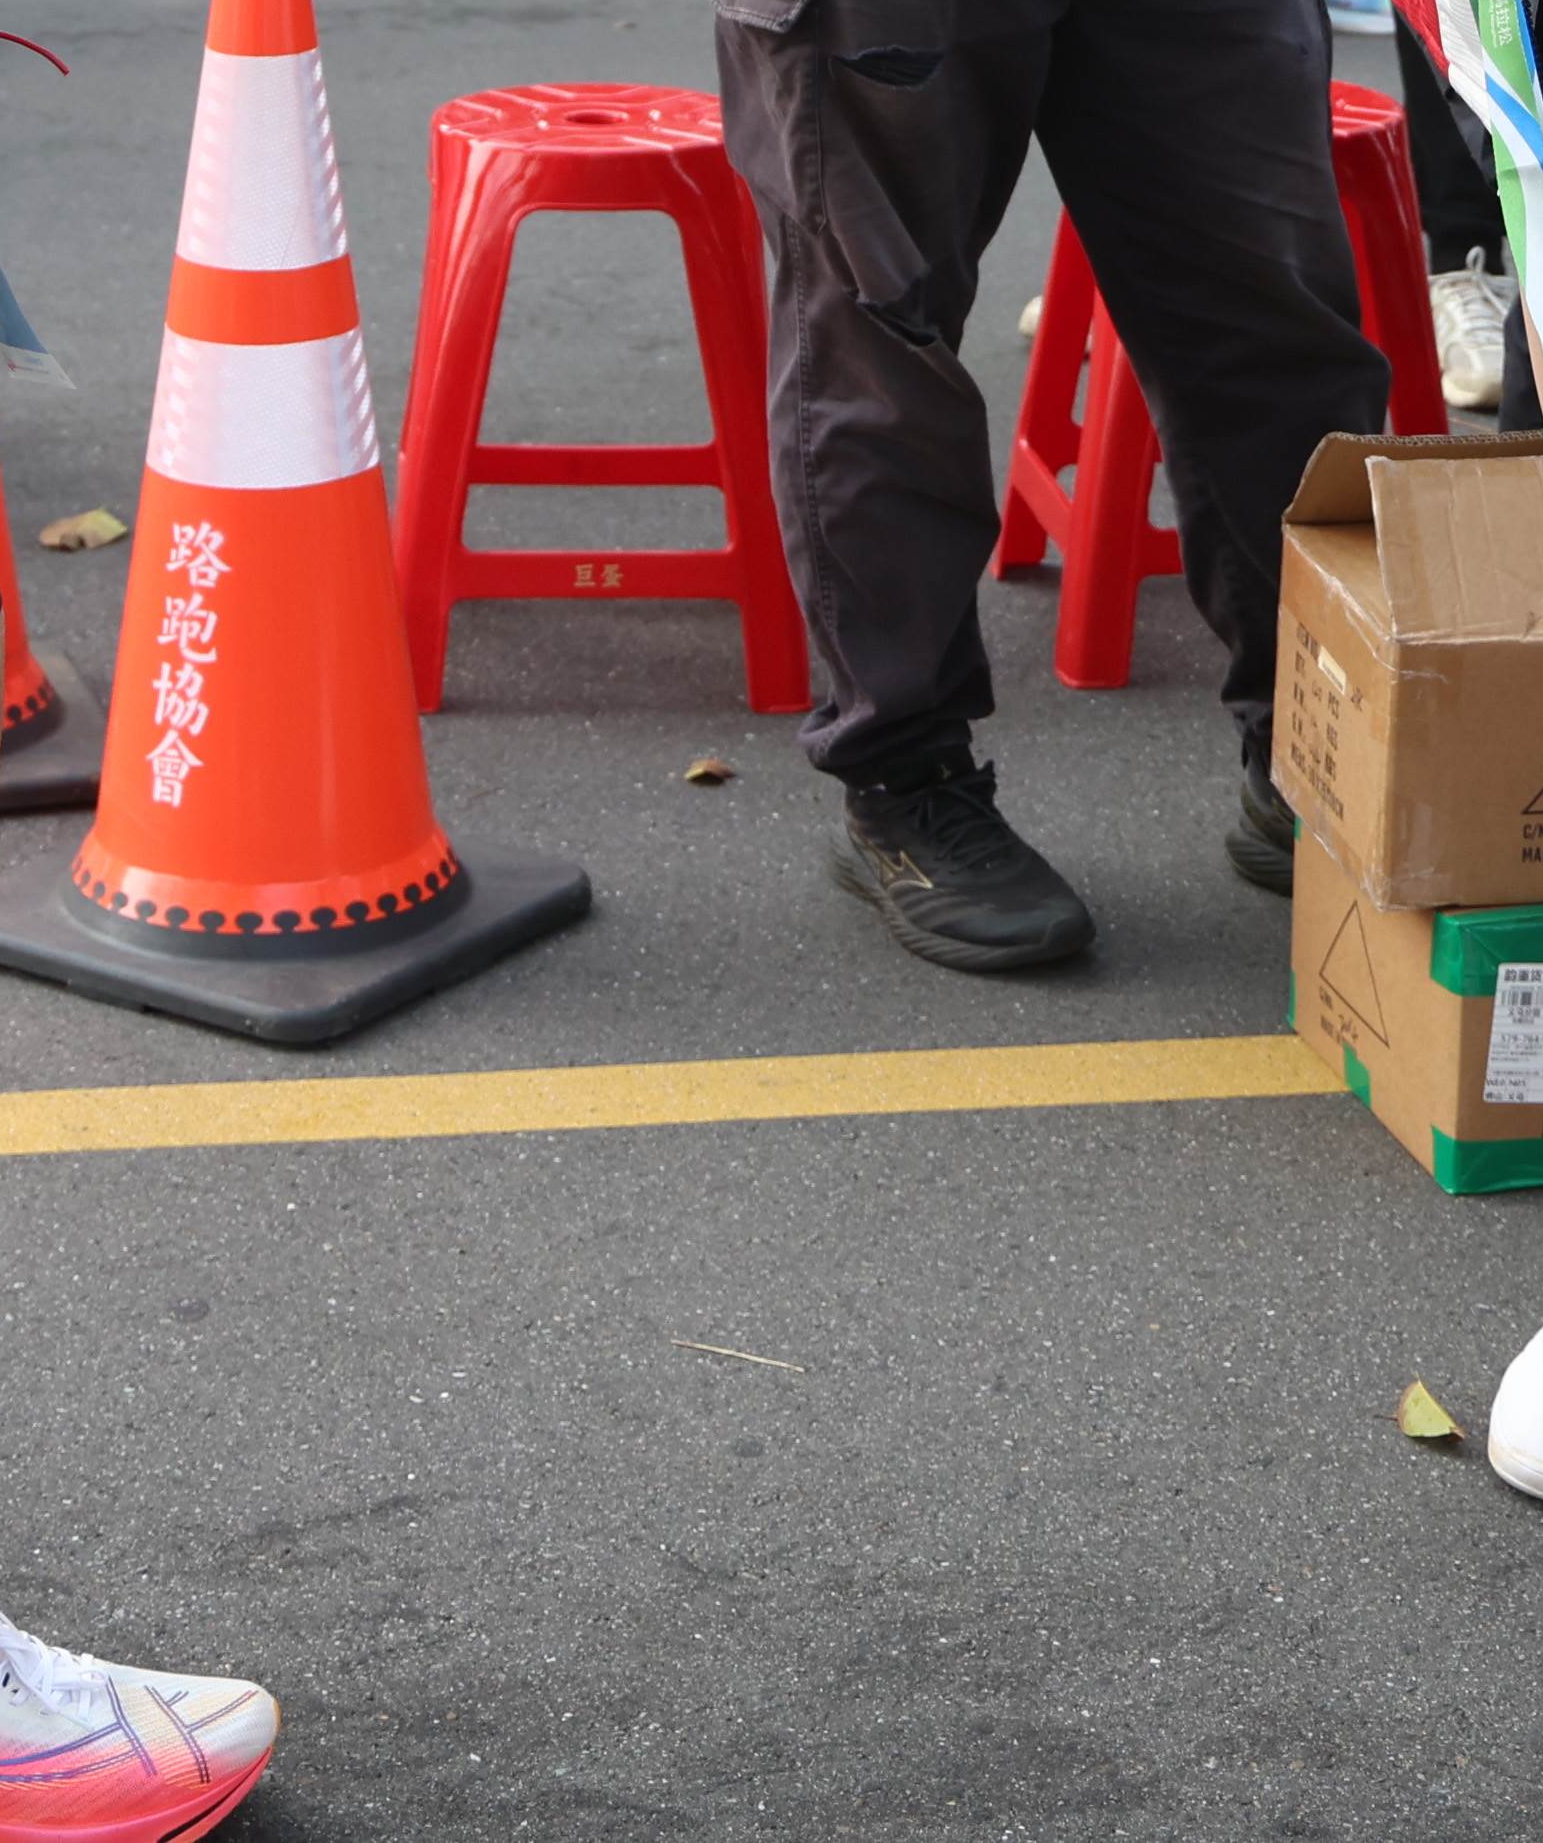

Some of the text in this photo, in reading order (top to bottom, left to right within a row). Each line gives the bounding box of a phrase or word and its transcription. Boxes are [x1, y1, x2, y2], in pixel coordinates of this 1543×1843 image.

[573, 563, 625, 588] 巨蛋
[145, 520, 232, 809] 路跑協會
